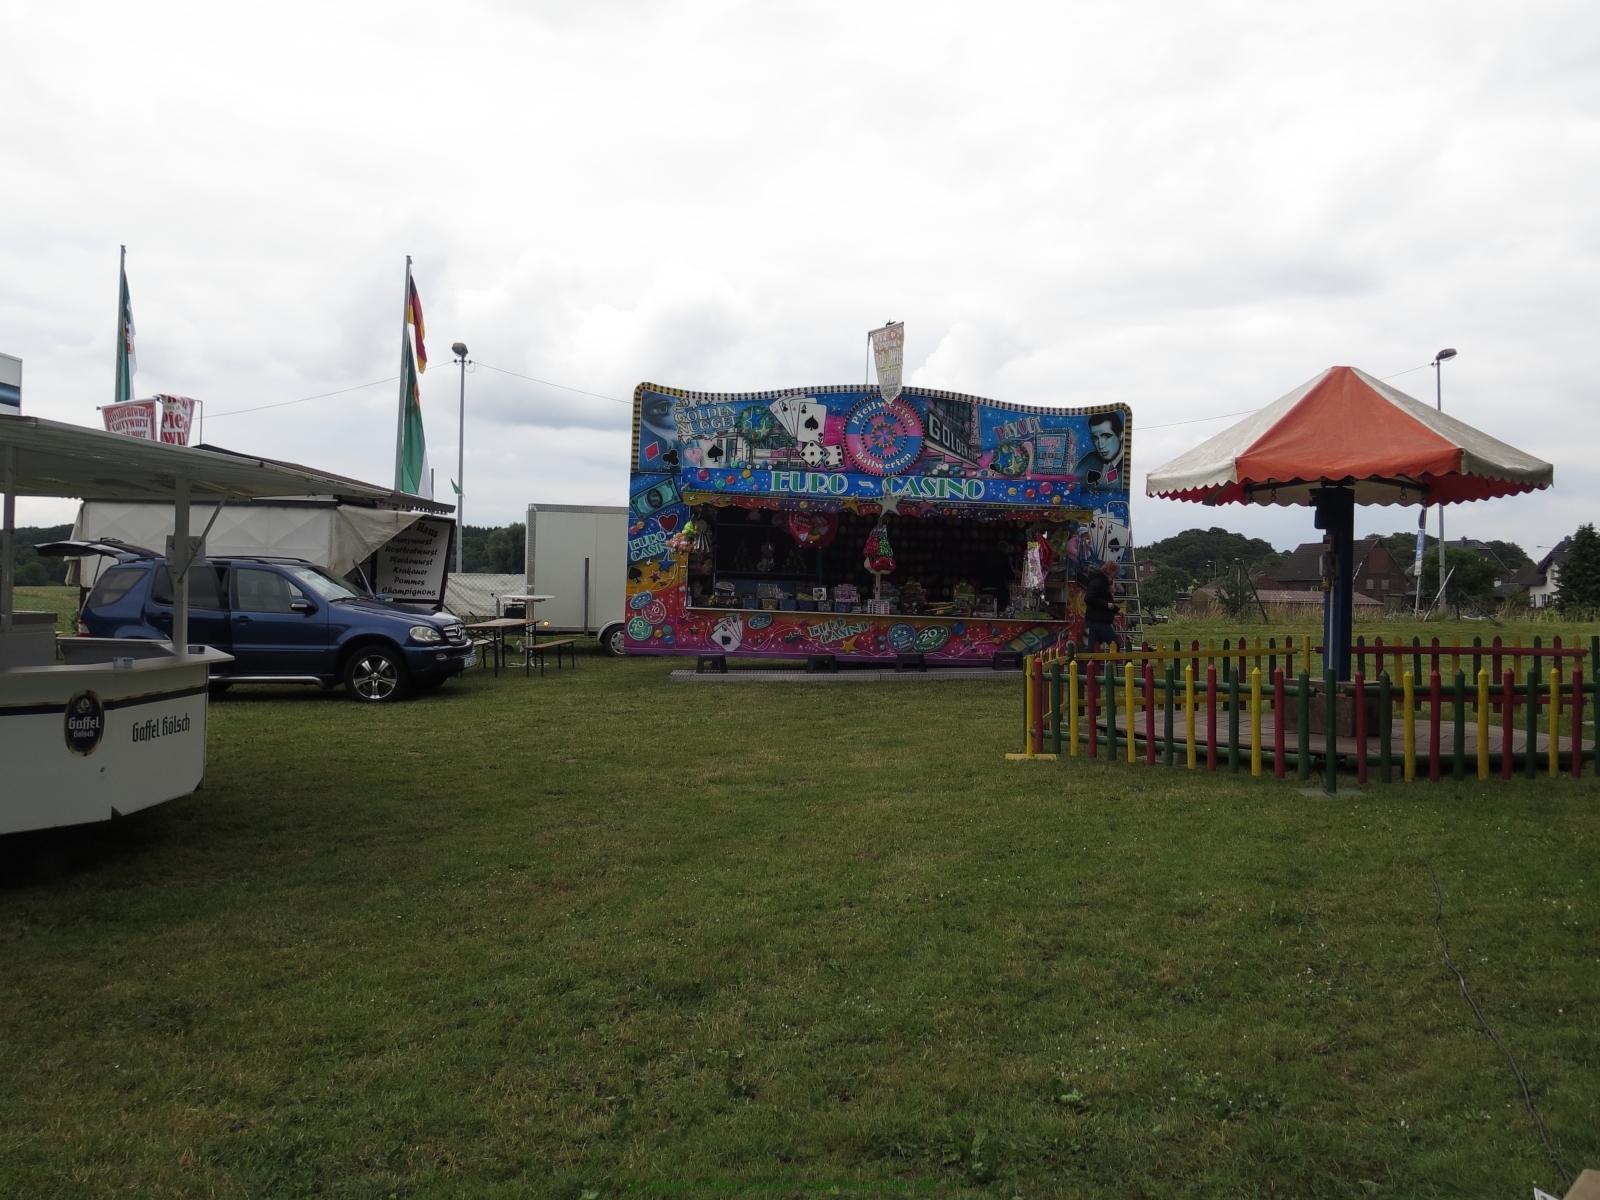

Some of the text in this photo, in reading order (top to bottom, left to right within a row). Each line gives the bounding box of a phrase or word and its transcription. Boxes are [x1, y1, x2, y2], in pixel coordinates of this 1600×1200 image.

[106, 407, 152, 424] Rostbratwurst
[674, 405, 736, 423] GOLDEN
[851, 401, 915, 427] Pfeilwerfen
[112, 418, 149, 432] Currywurst
[677, 415, 736, 434] NUGGET
[993, 415, 1043, 443] PAYOUT
[929, 413, 968, 459] GOLDEN
[855, 451, 912, 469] Ballwerfen
[770, 470, 849, 494] EURO
[882, 475, 986, 501] CASINO
[416, 521, 439, 538] Haus
[391, 535, 433, 546] Currywurst
[385, 545, 438, 556] Rostbratwurst
[389, 555, 434, 566] Pferdewurst
[392, 566, 428, 576] Krakauer
[393, 576, 426, 586] Pommes
[381, 586, 436, 597] Champignons
[820, 620, 870, 644] CASINO
[920, 628, 938, 642] 20
[68, 715, 100, 730] Gaffel
[132, 712, 190, 743] Gaffel Kölsch
[73, 729, 95, 738] Kölsch
